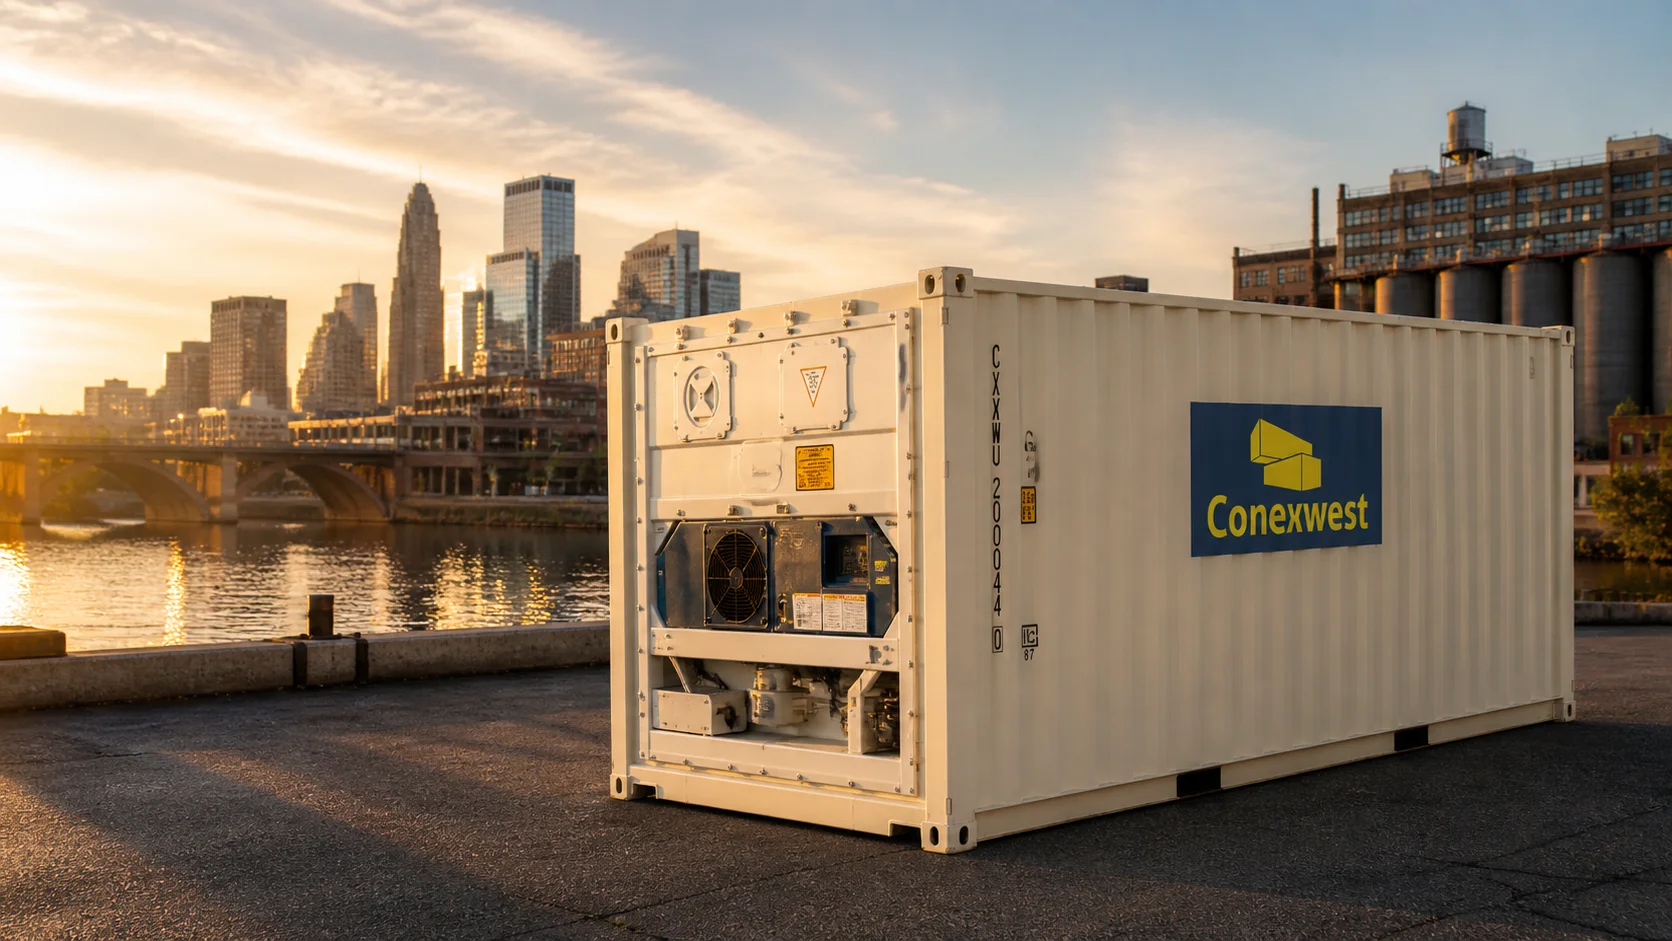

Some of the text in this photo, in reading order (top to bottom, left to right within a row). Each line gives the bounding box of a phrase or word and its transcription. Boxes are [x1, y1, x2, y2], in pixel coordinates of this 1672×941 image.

[992, 344, 1001, 468] CXXWU
[993, 477, 1002, 617] 200044
[1207, 493, 1369, 539] Conexwest
[1024, 648, 1035, 661] 87
